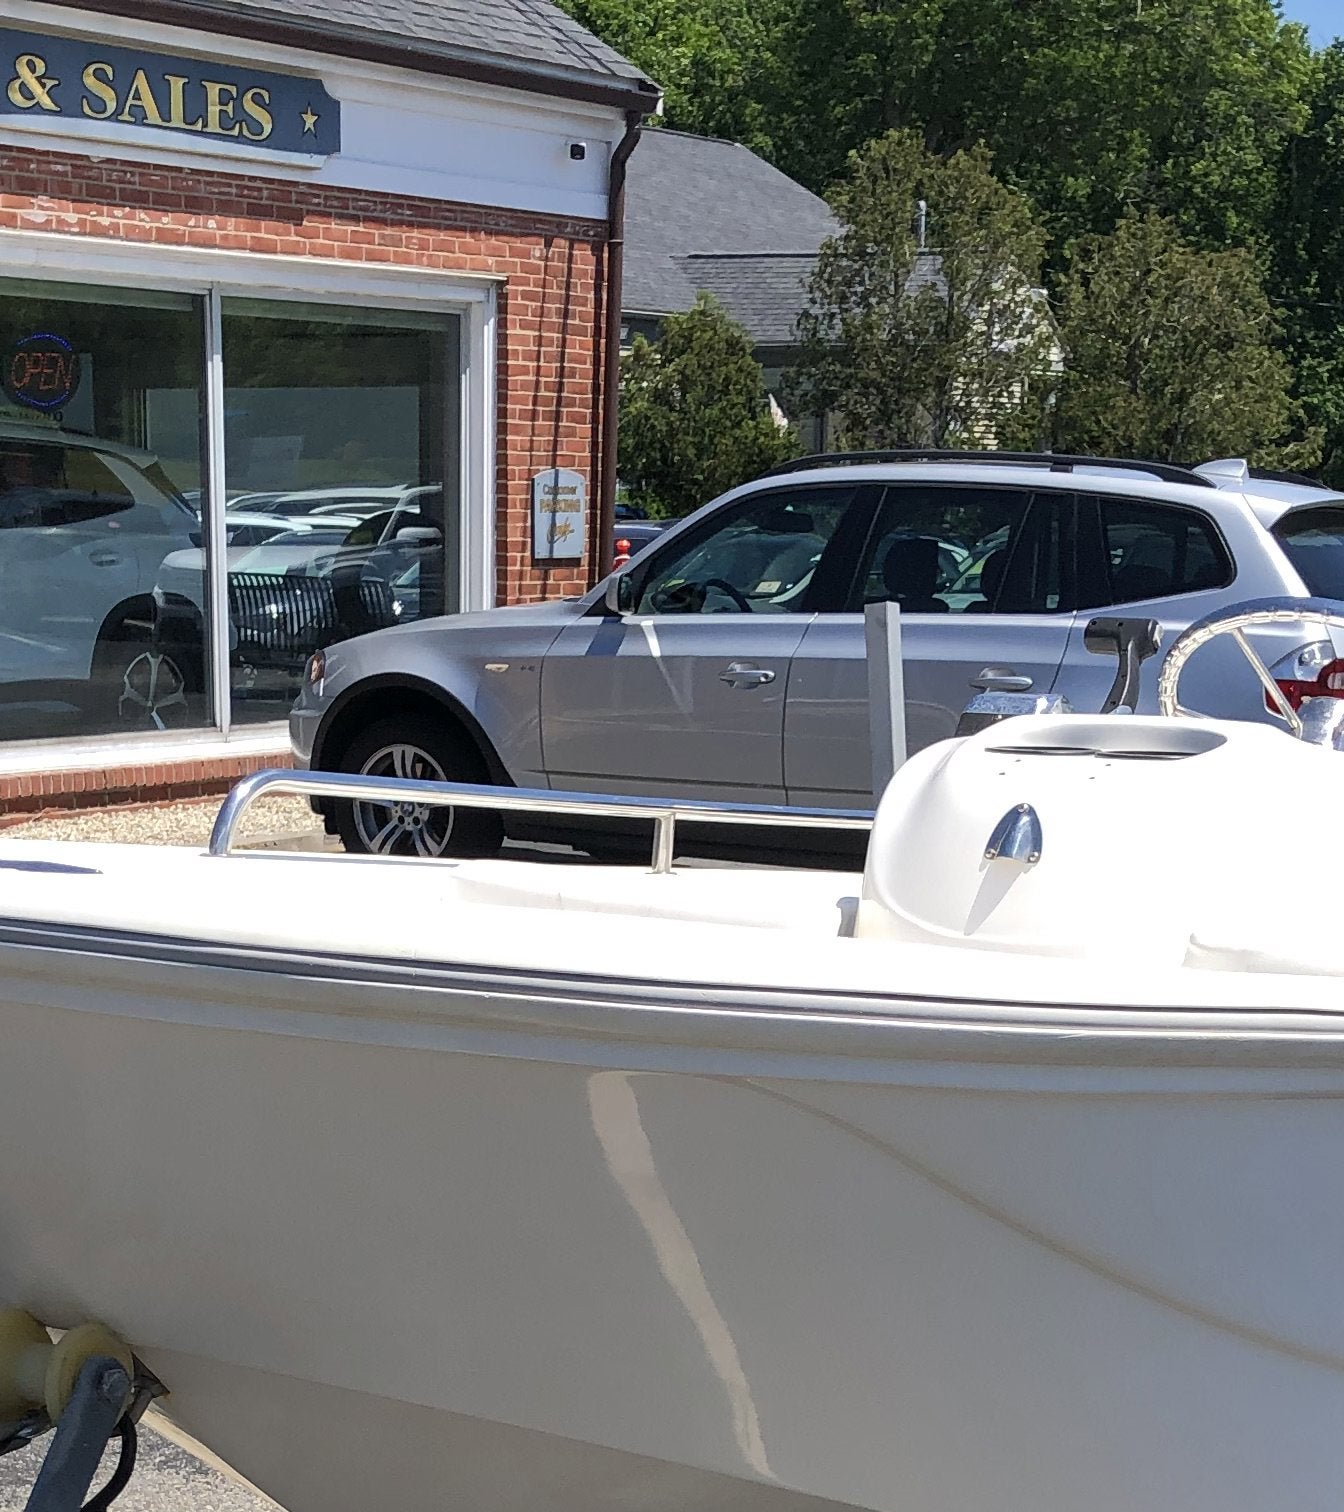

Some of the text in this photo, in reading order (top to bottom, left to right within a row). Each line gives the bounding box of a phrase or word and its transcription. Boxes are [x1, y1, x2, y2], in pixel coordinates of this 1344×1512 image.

[6, 52, 61, 112] &
[81, 61, 275, 141] SALES
[11, 352, 76, 390] OPEN
